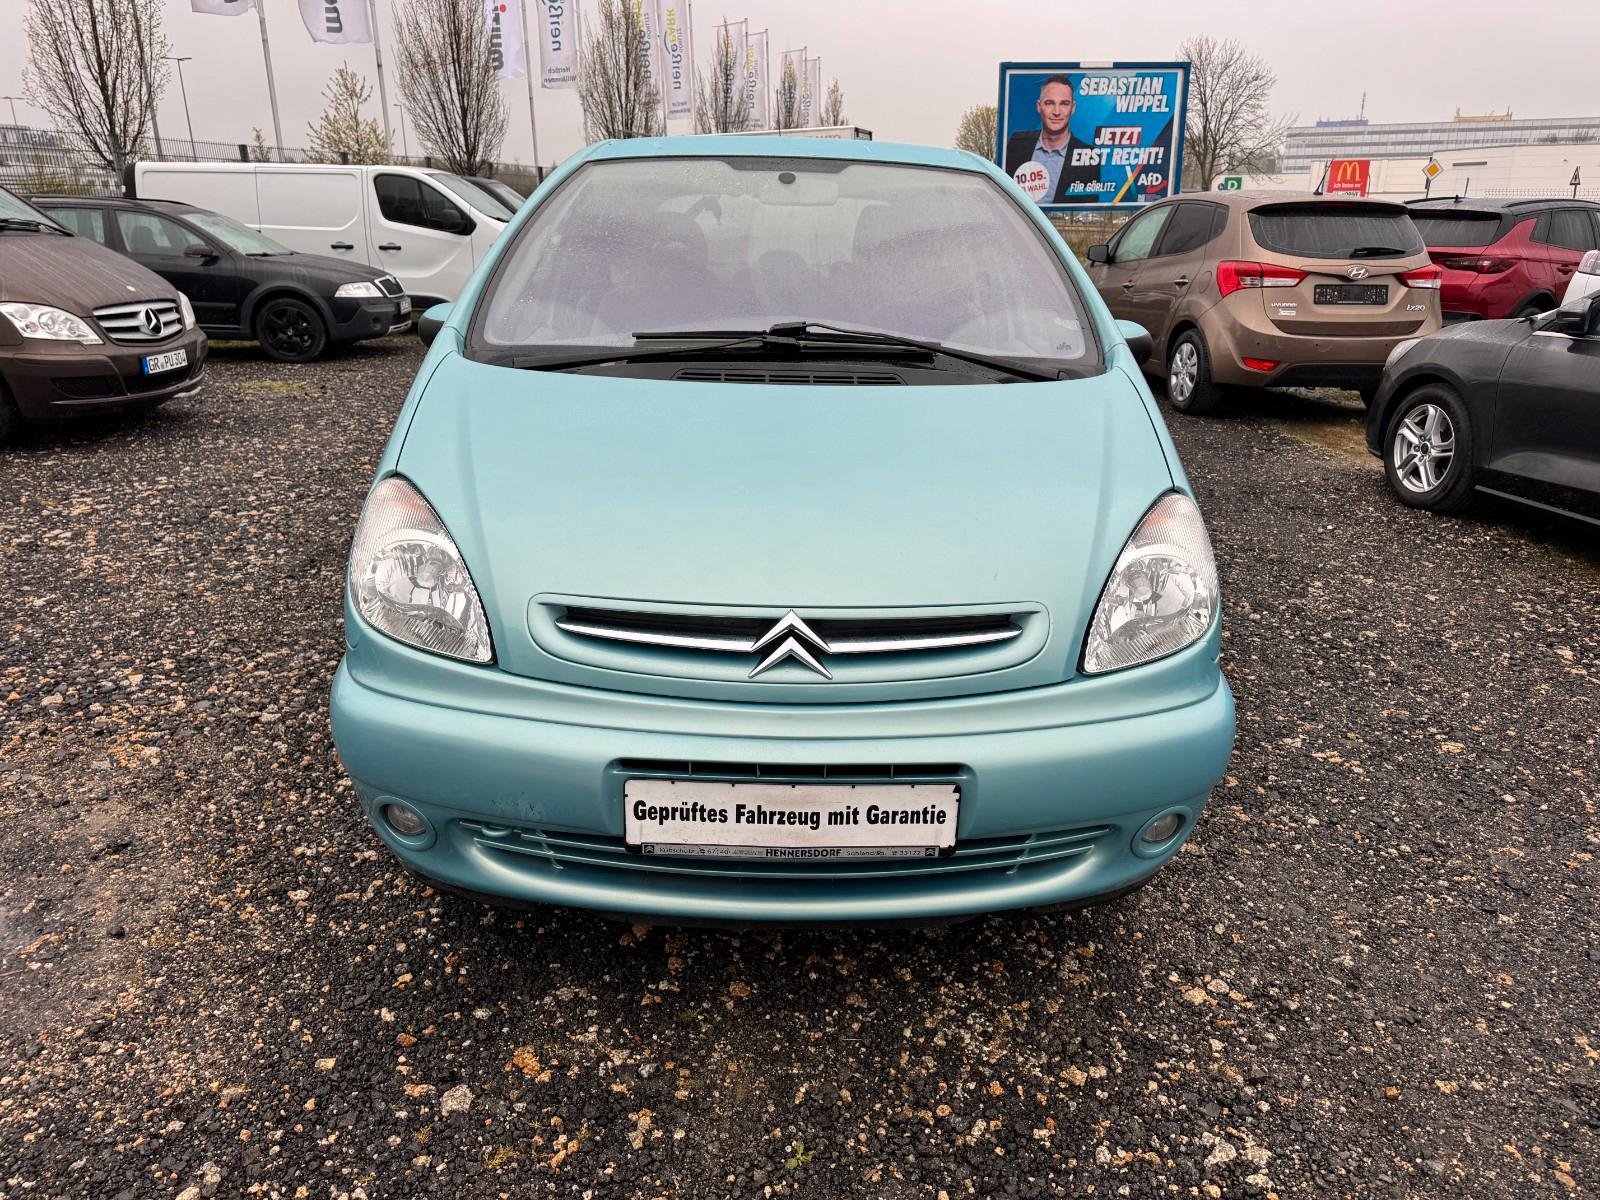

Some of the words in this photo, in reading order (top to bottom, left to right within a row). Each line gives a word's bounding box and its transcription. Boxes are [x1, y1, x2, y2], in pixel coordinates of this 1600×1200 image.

[1080, 77, 1163, 95] SEBASTIAN
[1116, 95, 1169, 113] WIPPEL
[1094, 127, 1142, 146] JETZT
[1071, 148, 1110, 166] ERST
[1111, 147, 1164, 165] RECHT!
[1016, 170, 1047, 185] 10.05.
[1138, 172, 1162, 186] AfD
[1070, 180, 1085, 193] FÜR
[1086, 180, 1116, 192] GÖRLITZ
[149, 357, 160, 372] GR
[633, 800, 728, 825] Geprüftes
[735, 804, 821, 830] Fahrzeug
[828, 805, 859, 825] mit
[866, 804, 947, 825] Garantie
[765, 848, 842, 858] HENNERSDORF
